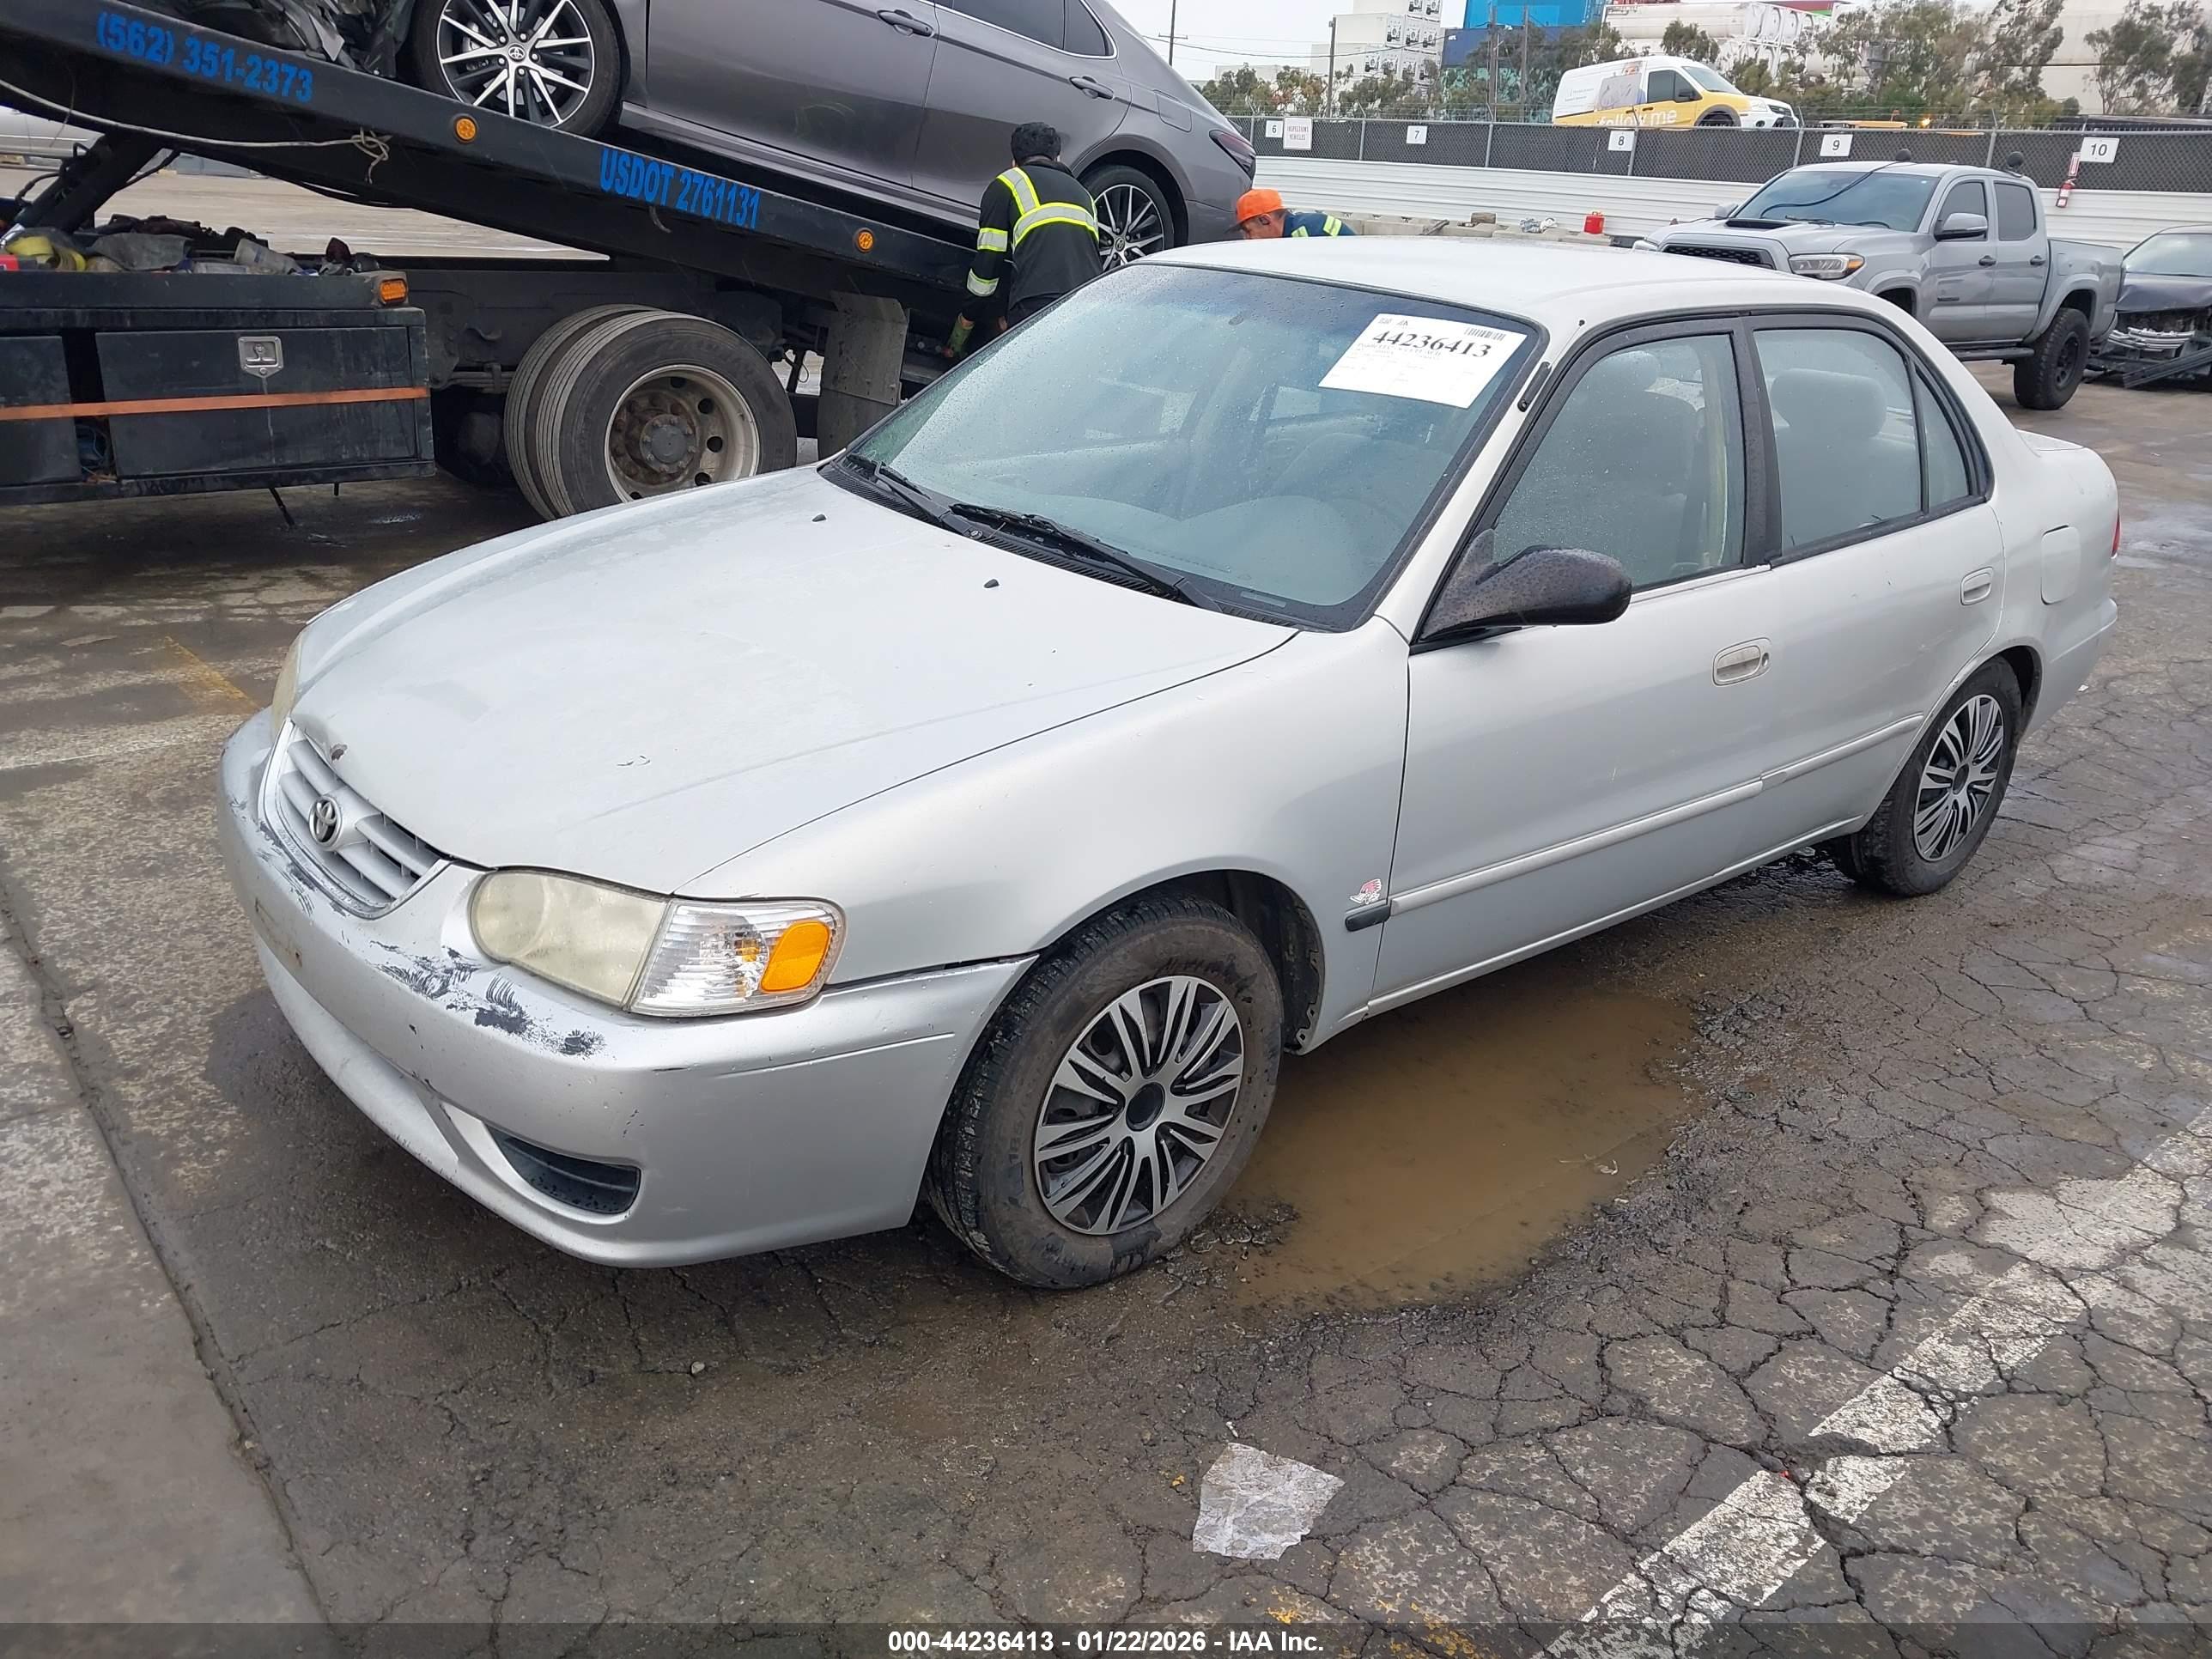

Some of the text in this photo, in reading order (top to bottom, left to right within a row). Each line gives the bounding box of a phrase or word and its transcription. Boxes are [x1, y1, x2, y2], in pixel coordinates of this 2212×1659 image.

[98, 12, 313, 104] (562) 351-2373
[1650, 109, 1677, 125] me
[1272, 125, 1278, 134] 6
[1414, 131, 1420, 139] 7
[1618, 136, 1625, 146] 8
[1832, 140, 1840, 151] 9
[2090, 143, 2107, 156] 10
[600, 148, 761, 230] USDOT 2761131
[1372, 331, 1492, 357] 44236413
